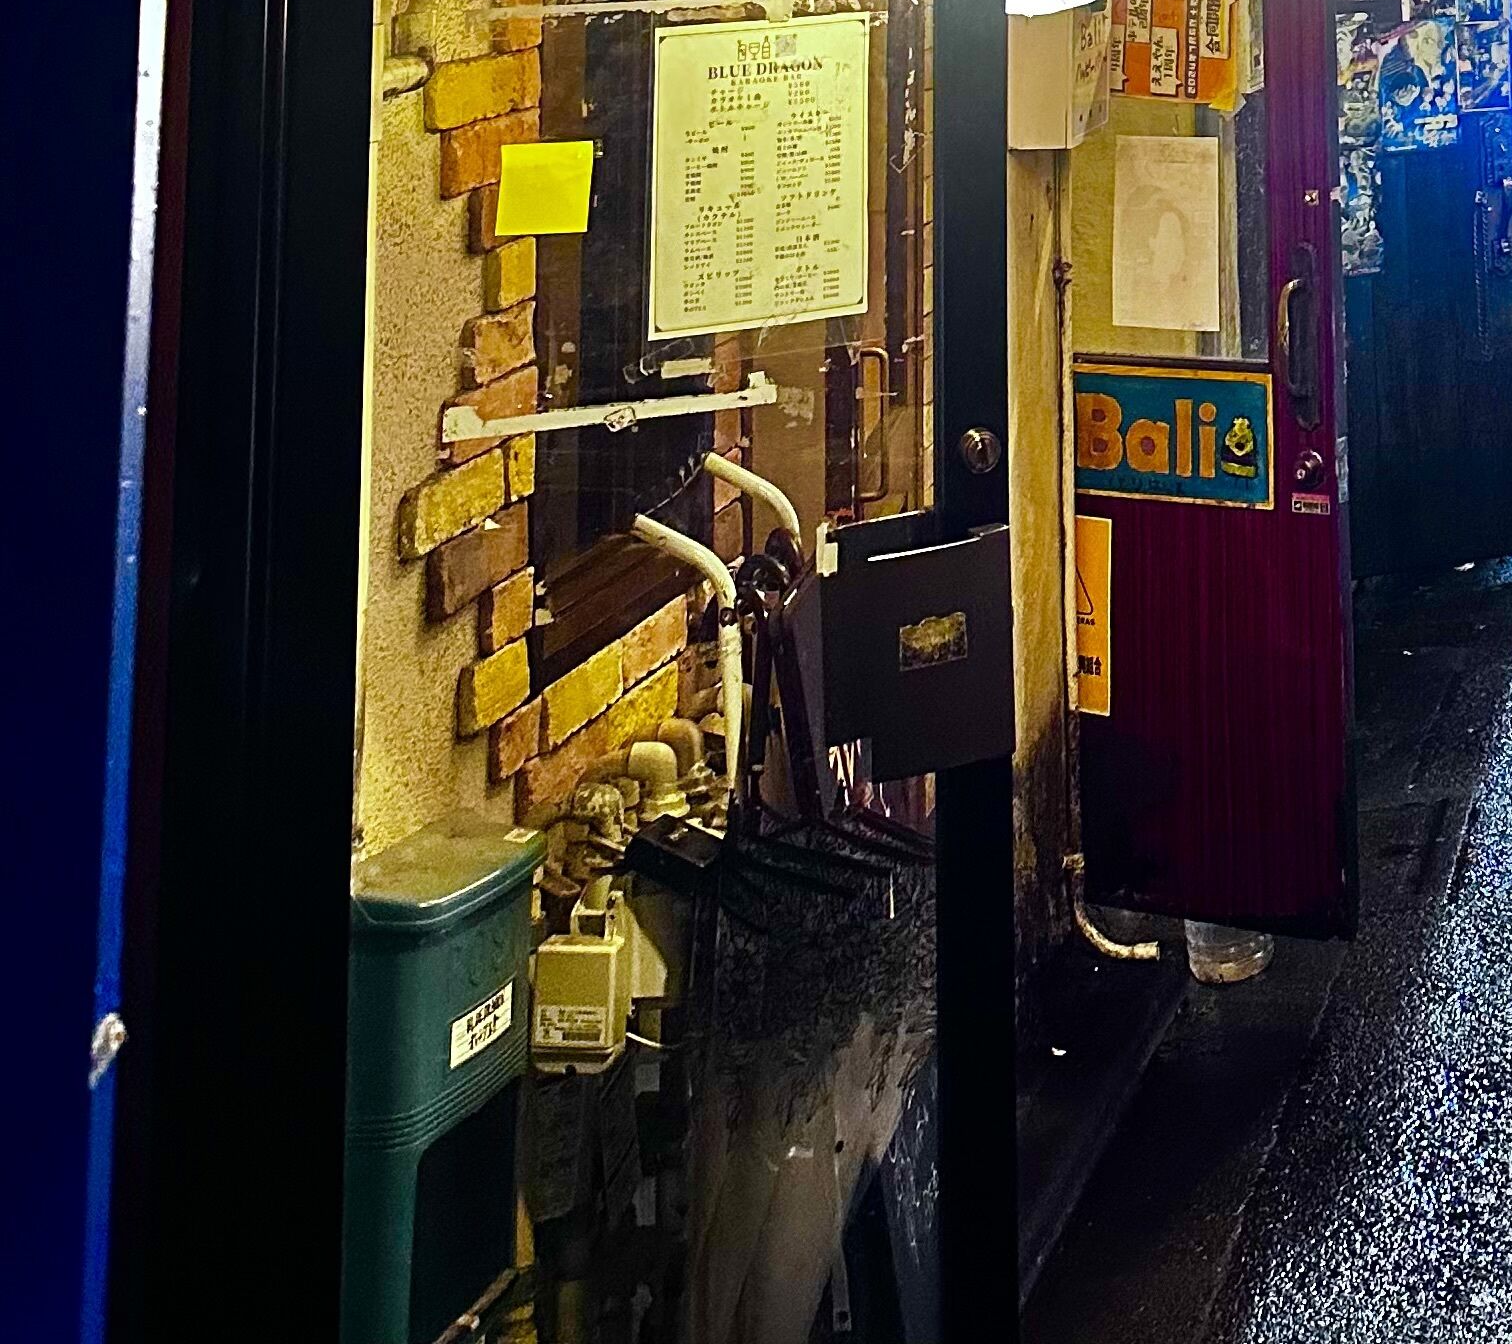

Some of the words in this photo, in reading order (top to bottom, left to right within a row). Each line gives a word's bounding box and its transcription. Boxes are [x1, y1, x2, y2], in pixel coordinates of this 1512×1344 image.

[708, 64, 751, 80] BLUE
[757, 56, 824, 76] DRAGON
[1076, 392, 1217, 480] Bali
